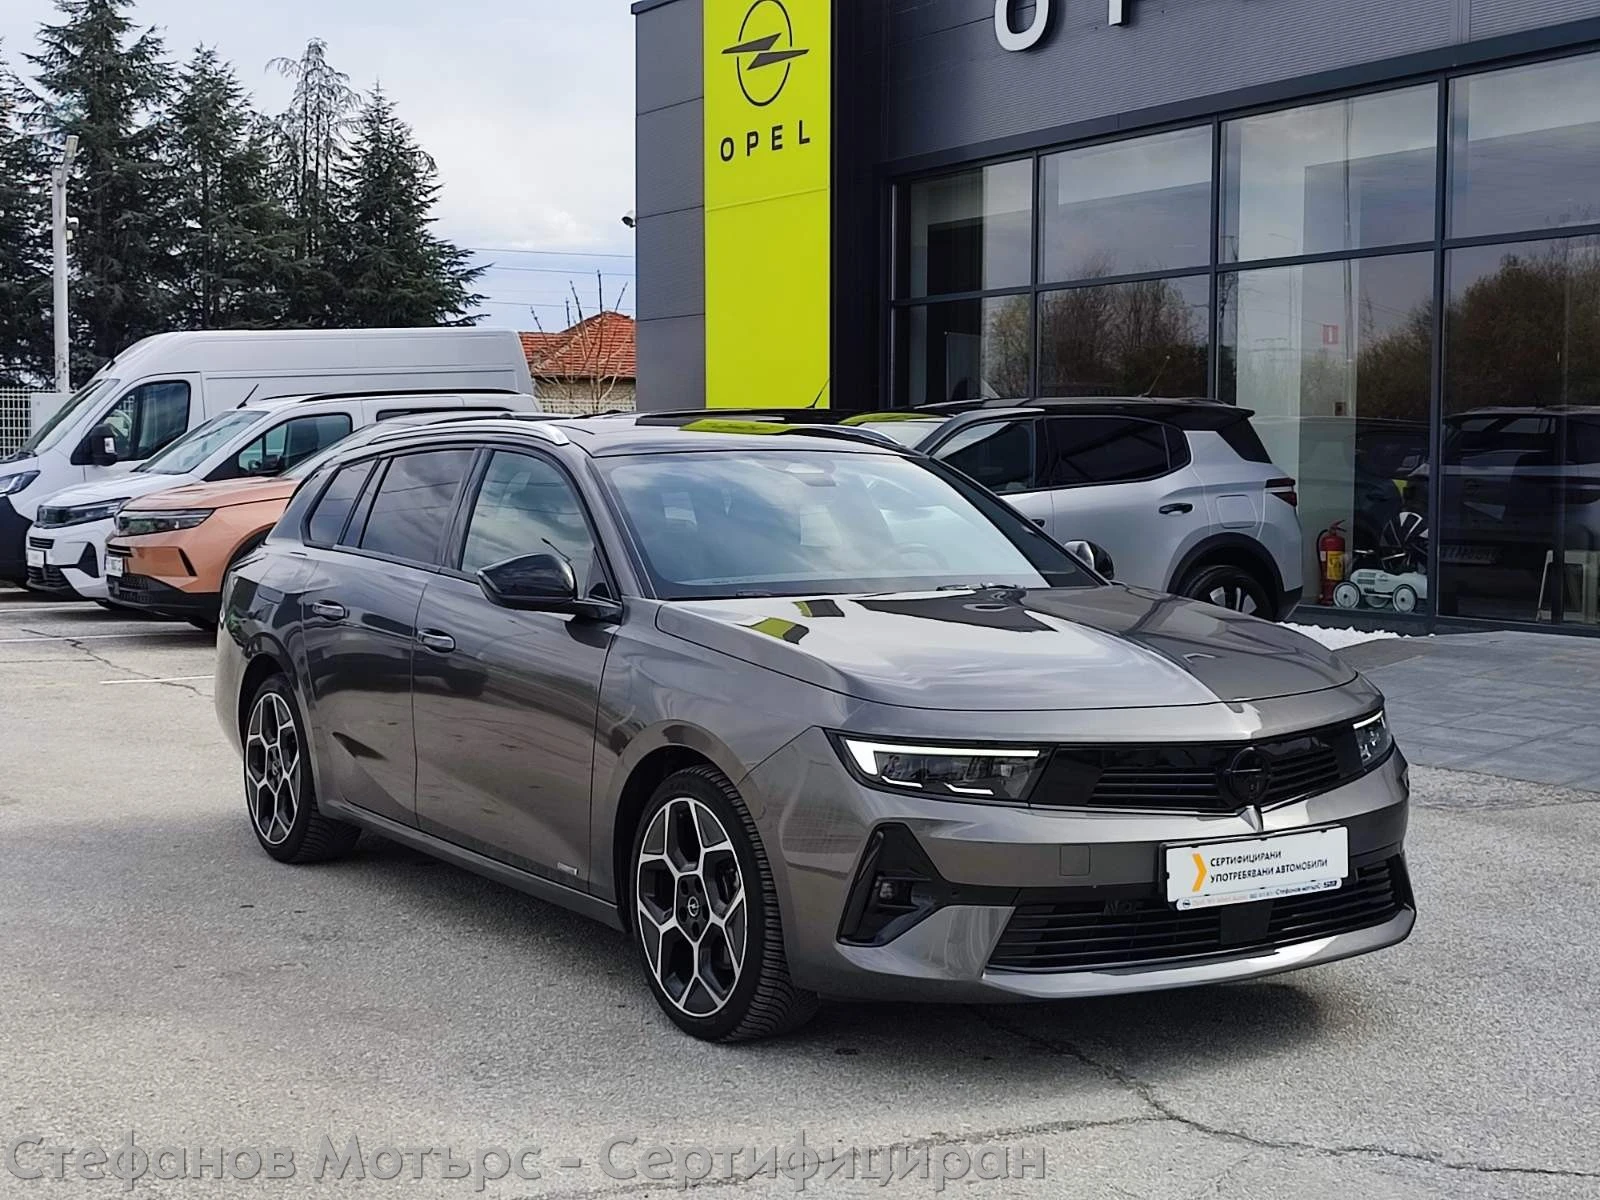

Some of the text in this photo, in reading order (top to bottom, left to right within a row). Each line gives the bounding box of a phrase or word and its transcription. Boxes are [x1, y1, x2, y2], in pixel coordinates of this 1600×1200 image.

[720, 119, 811, 162] OPEL
[1210, 850, 1282, 867] СЕРТИФИЦИРАНИ
[1210, 858, 1328, 883] УПОТРЕБЯВАНИ АВТОМОБИЛИ
